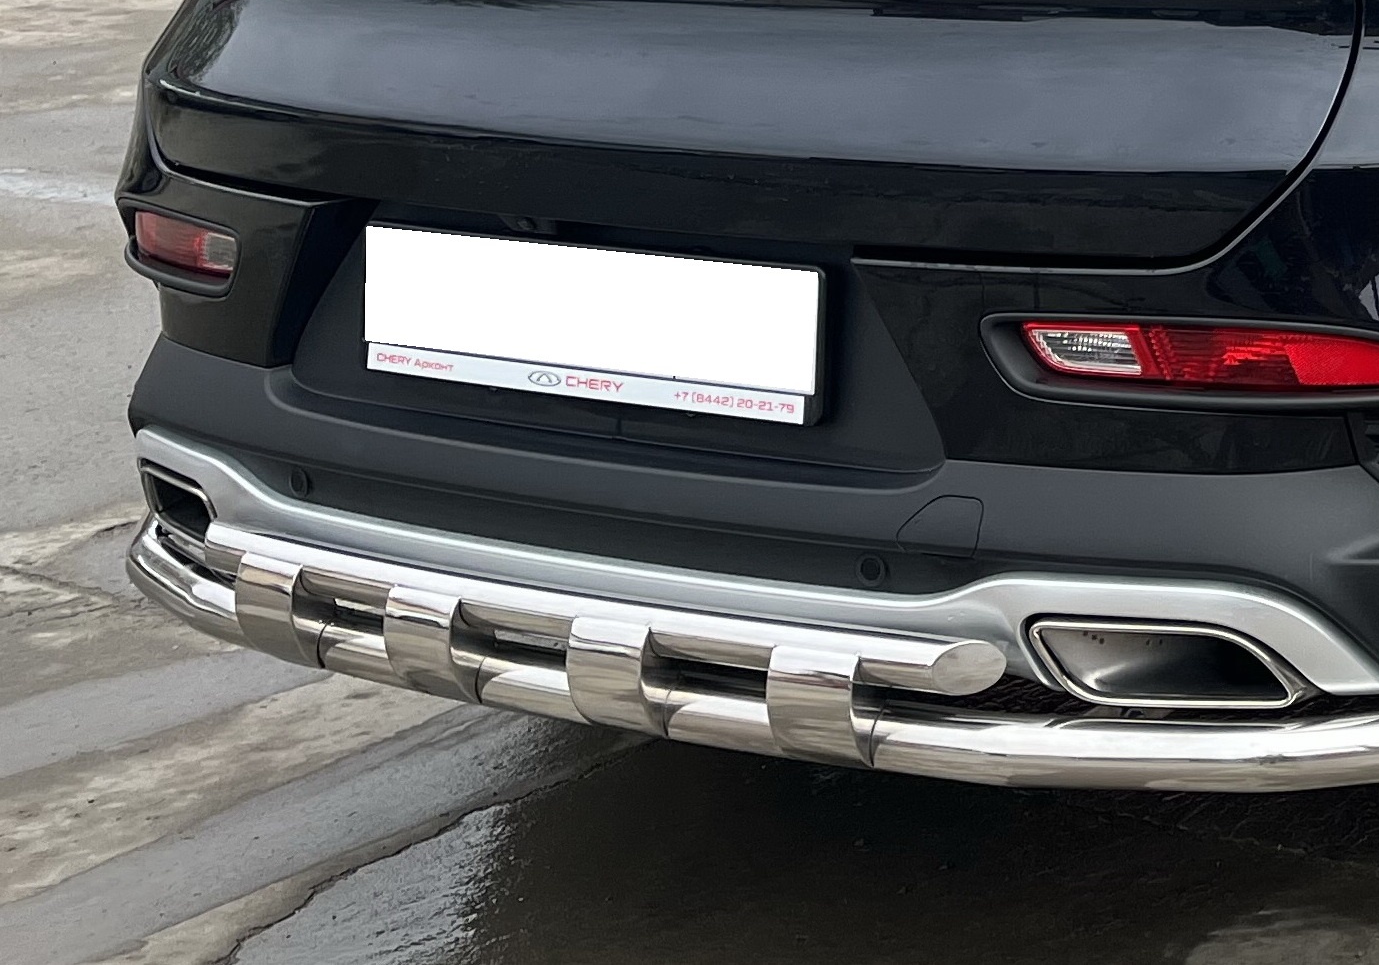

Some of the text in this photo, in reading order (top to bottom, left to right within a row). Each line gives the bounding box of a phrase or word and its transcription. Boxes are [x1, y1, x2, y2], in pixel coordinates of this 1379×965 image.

[376, 352, 412, 365] CHERY
[565, 375, 623, 393] CHERY
[674, 391, 689, 402] +7
[736, 398, 795, 414] 20-21-79
